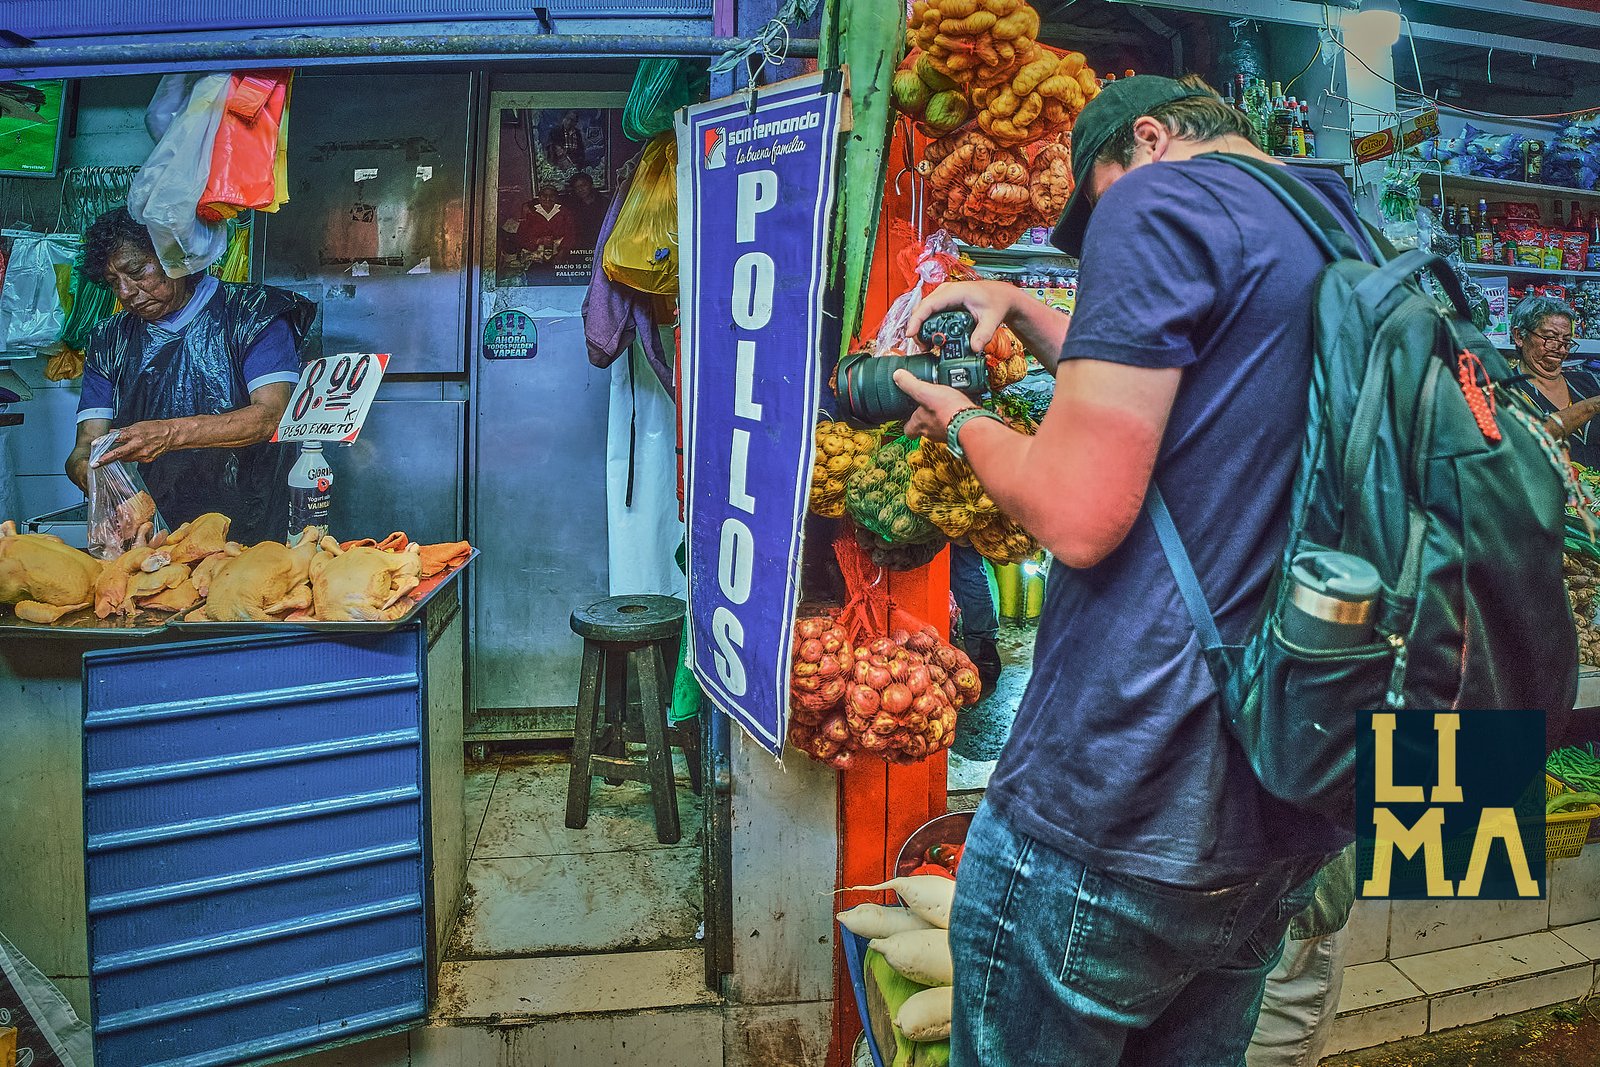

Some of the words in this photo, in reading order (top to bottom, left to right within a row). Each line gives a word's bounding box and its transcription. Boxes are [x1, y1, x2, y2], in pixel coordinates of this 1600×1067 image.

[728, 127, 751, 146] san
[752, 111, 820, 140] fernando
[746, 145, 772, 162] buena
[770, 135, 806, 165] familia
[494, 335, 527, 344] AHORA
[493, 349, 528, 357] YAPEAR
[281, 423, 308, 440] PESO
[308, 422, 354, 435] EXACTO
[712, 169, 778, 699] POLLOS
